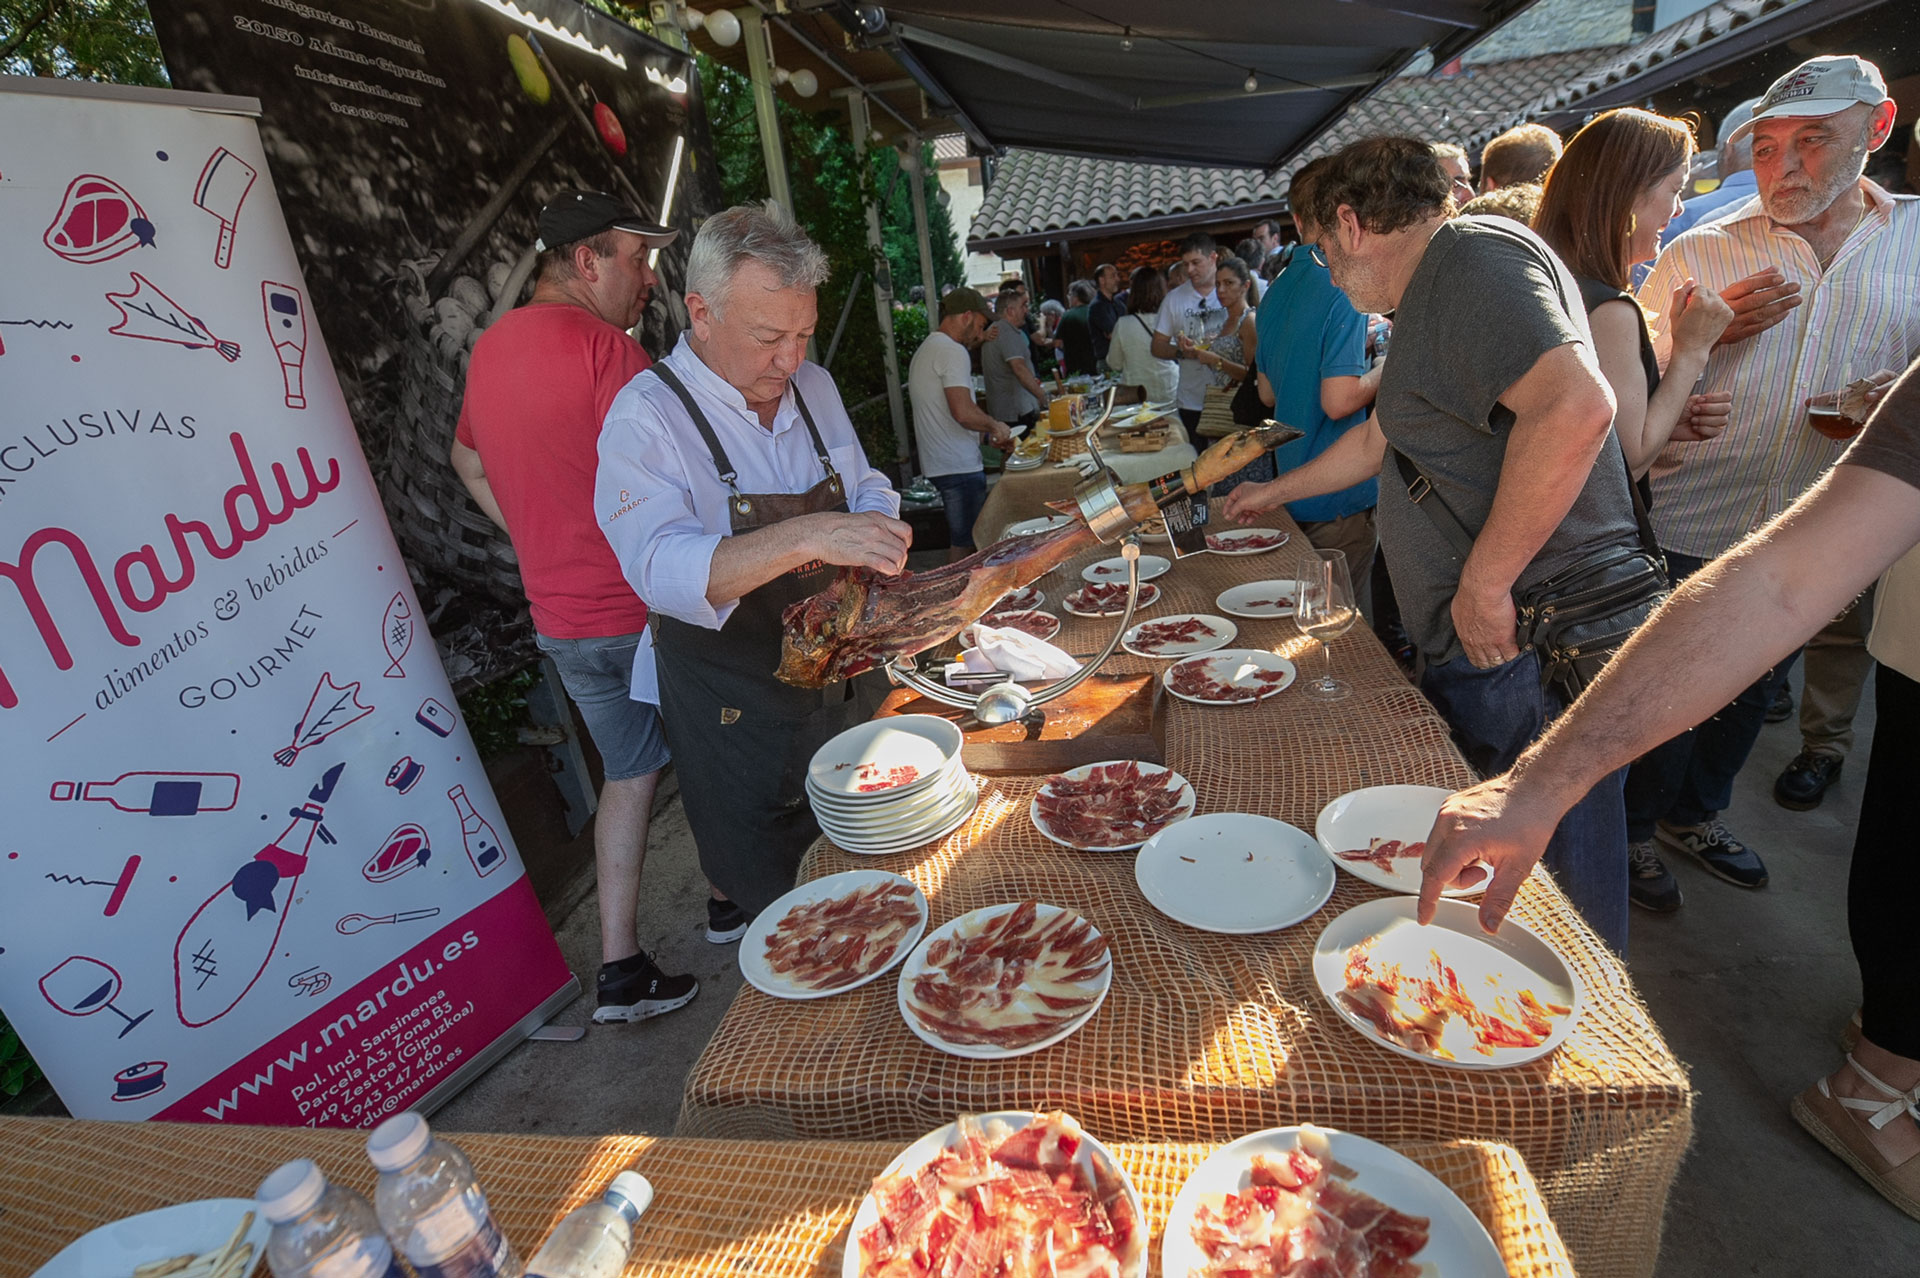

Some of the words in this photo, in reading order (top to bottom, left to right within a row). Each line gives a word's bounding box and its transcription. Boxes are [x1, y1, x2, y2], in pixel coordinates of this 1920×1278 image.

[234, 16, 304, 46] 20150
[95, 619, 210, 711] alimentos
[213, 588, 242, 622] &
[246, 539, 329, 602] bebidas
[179, 604, 323, 709] GOURMET
[202, 930, 479, 1120] www.mardu.es
[290, 1074, 328, 1102] Pol.
[327, 1050, 361, 1076] Ind.
[360, 989, 446, 1053] Sansinenea
[297, 1068, 363, 1117] Parcela
[366, 1048, 393, 1071] A3,
[391, 1017, 432, 1048] Zona
[433, 1001, 453, 1021] B3
[340, 1060, 398, 1103] Zestoa
[397, 1000, 475, 1064] (Gipuzkoa)
[340, 1090, 383, 1124] t.943
[384, 1065, 413, 1090] 147
[414, 1043, 443, 1070] 460
